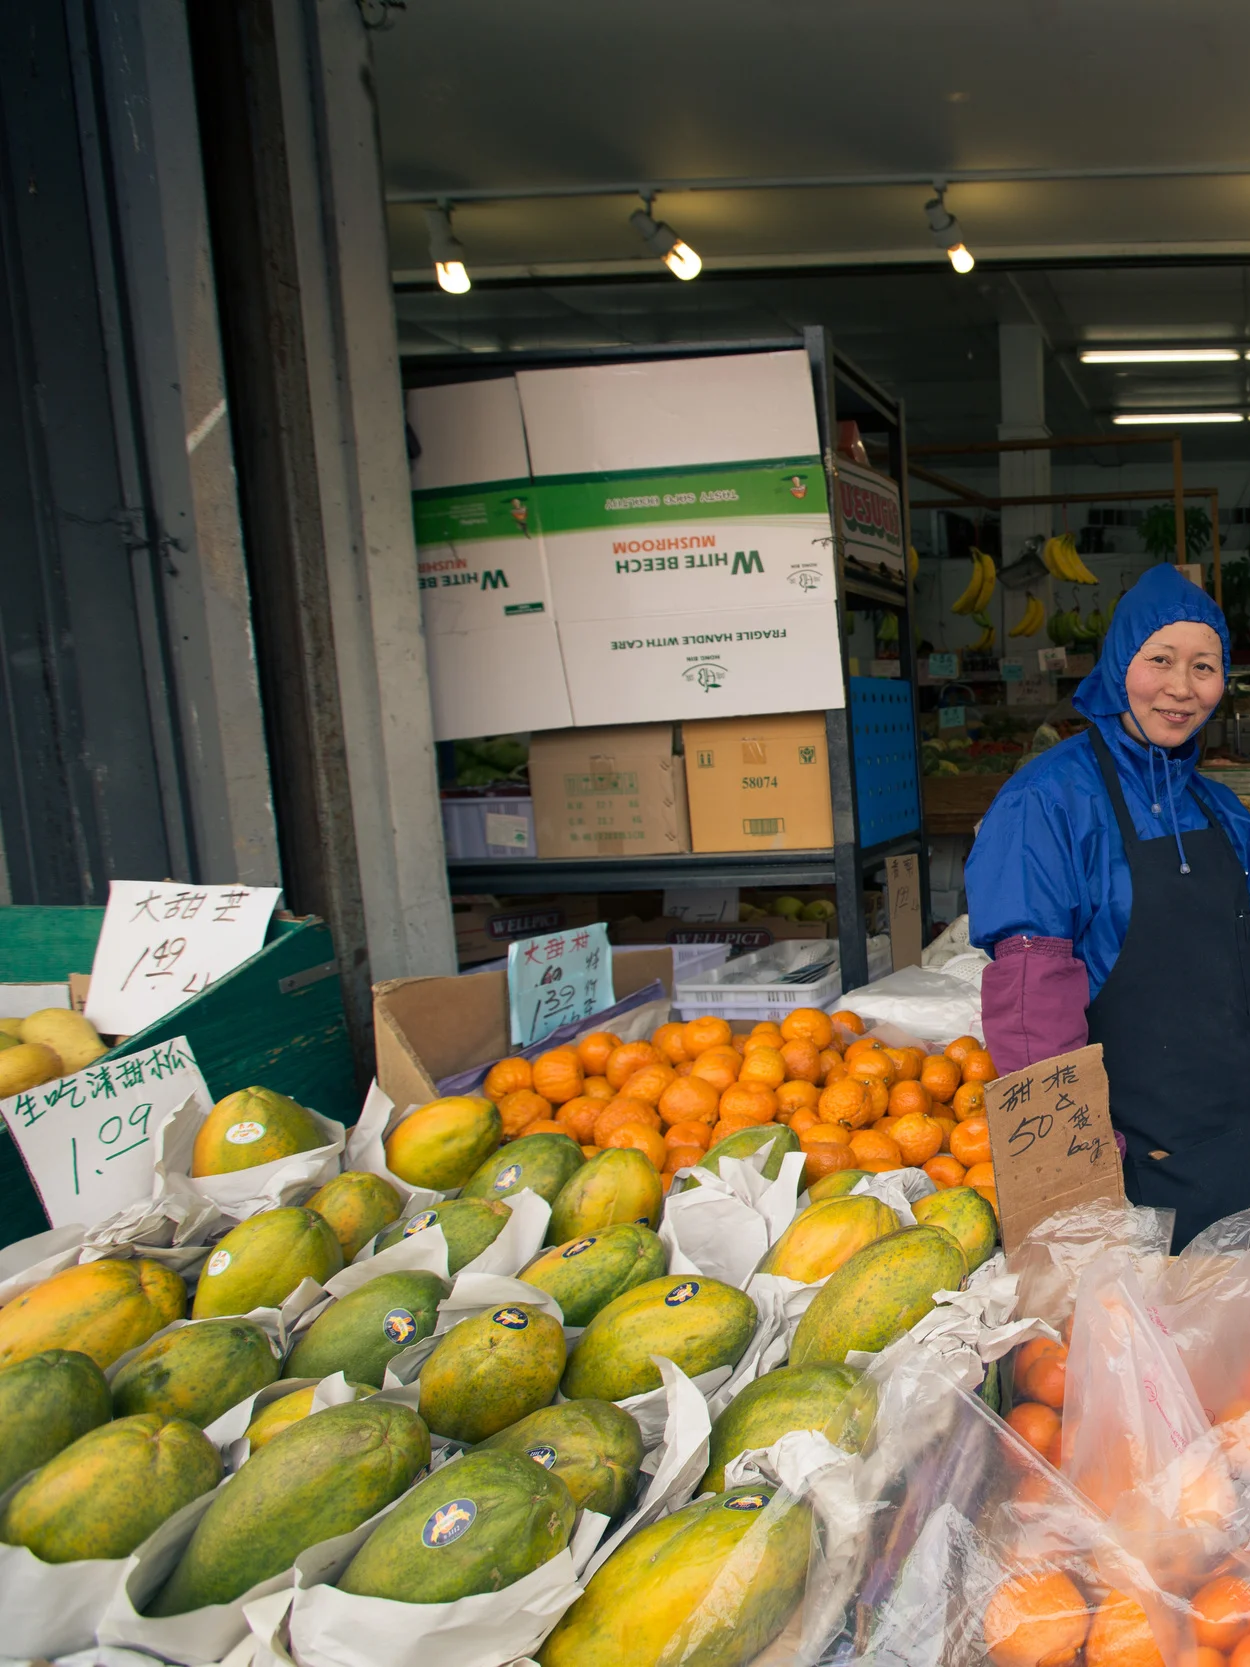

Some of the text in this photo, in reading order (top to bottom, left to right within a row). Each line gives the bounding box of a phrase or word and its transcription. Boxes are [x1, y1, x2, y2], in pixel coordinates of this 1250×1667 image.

[612, 535, 716, 555] MUSHROOM
[615, 550, 765, 576] WHITE BEECH
[442, 568, 509, 592] WHITE
[610, 628, 787, 651] FRAGILE HANDLE WITH CARE
[741, 776, 778, 789] 58074
